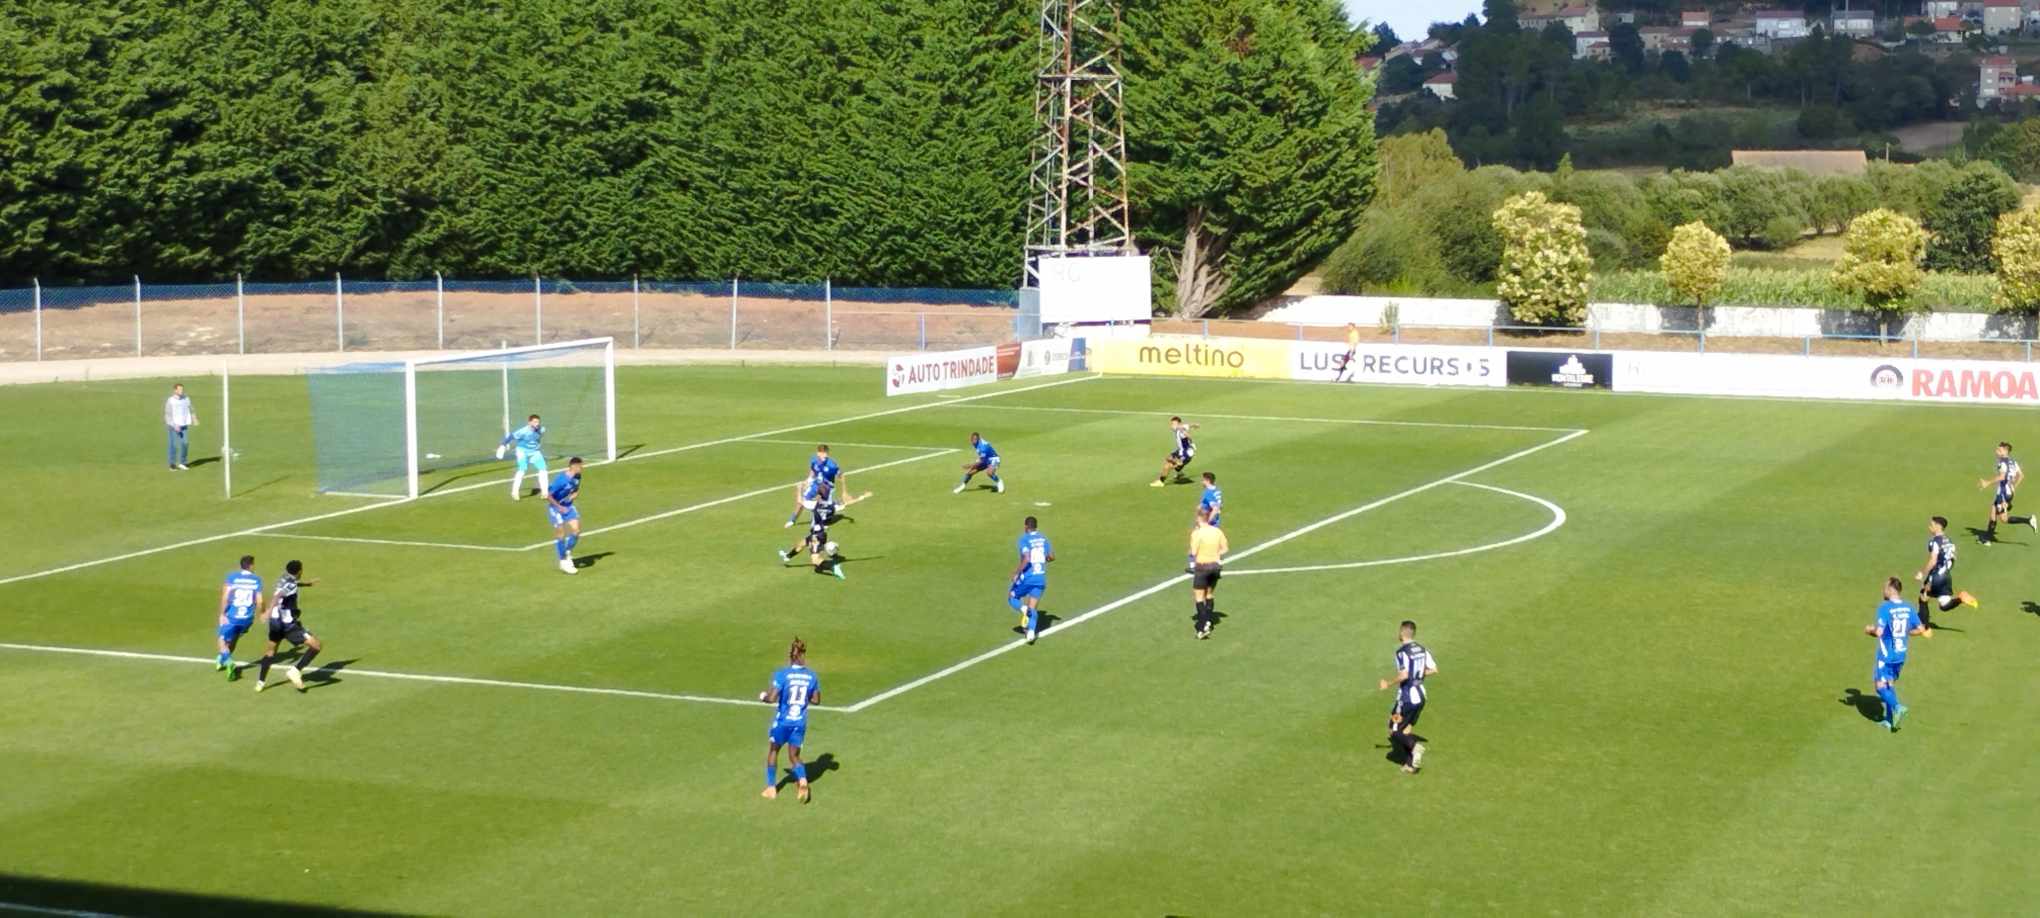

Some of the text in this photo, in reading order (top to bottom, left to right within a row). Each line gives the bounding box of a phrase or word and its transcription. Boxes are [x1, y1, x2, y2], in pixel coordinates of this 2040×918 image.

[908, 355, 994, 385] AUTO TRINDADE
[1139, 344, 1245, 369] meltino
[1911, 368, 2039, 400] RAMOA
